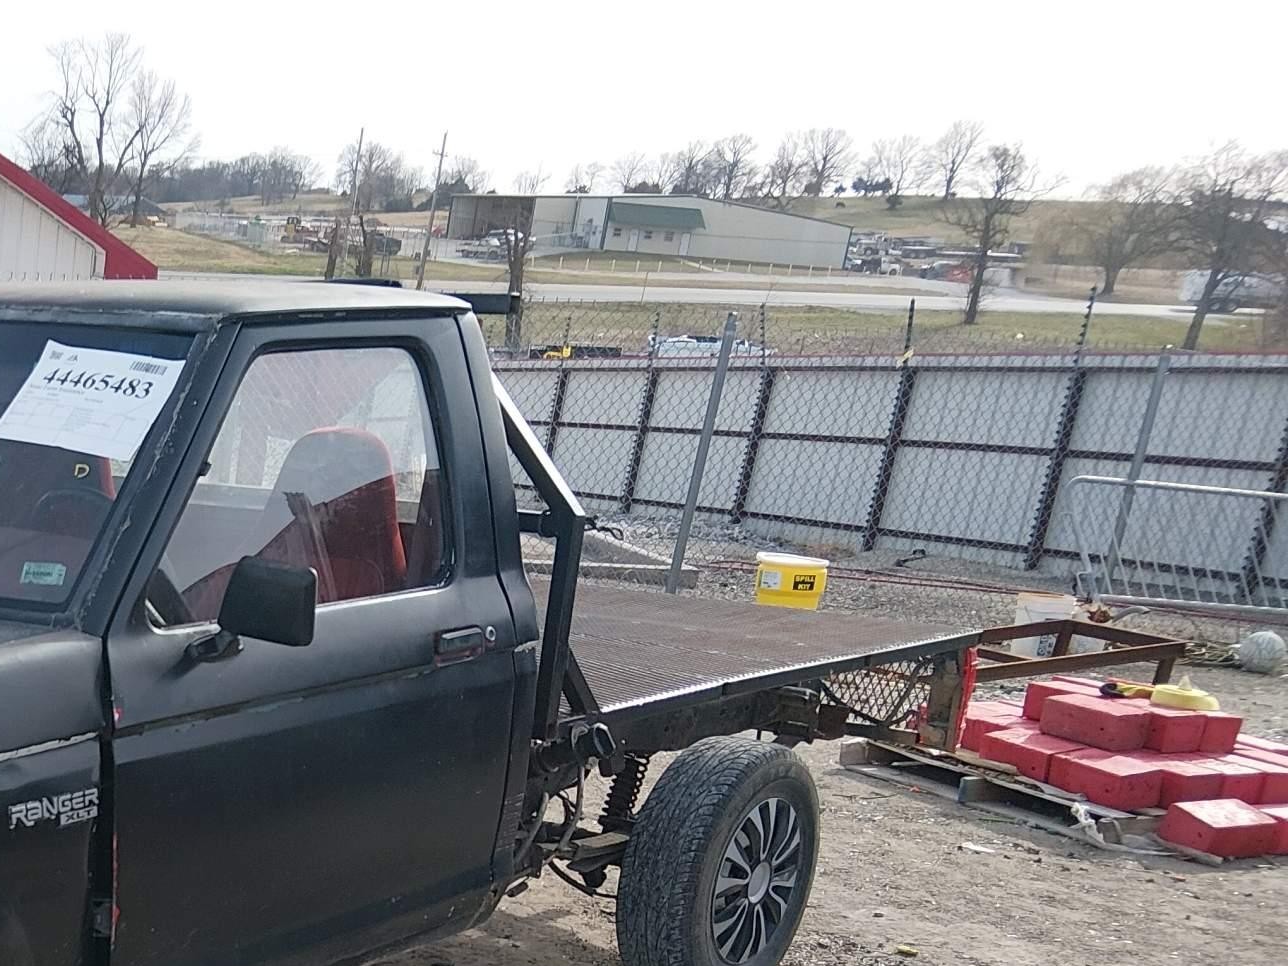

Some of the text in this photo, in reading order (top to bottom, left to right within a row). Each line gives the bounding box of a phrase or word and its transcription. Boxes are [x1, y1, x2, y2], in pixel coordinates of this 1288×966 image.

[43, 367, 154, 400] 44465483
[795, 575, 815, 583] SPILL
[8, 787, 100, 829] RANGER
[63, 806, 97, 824] XLT
